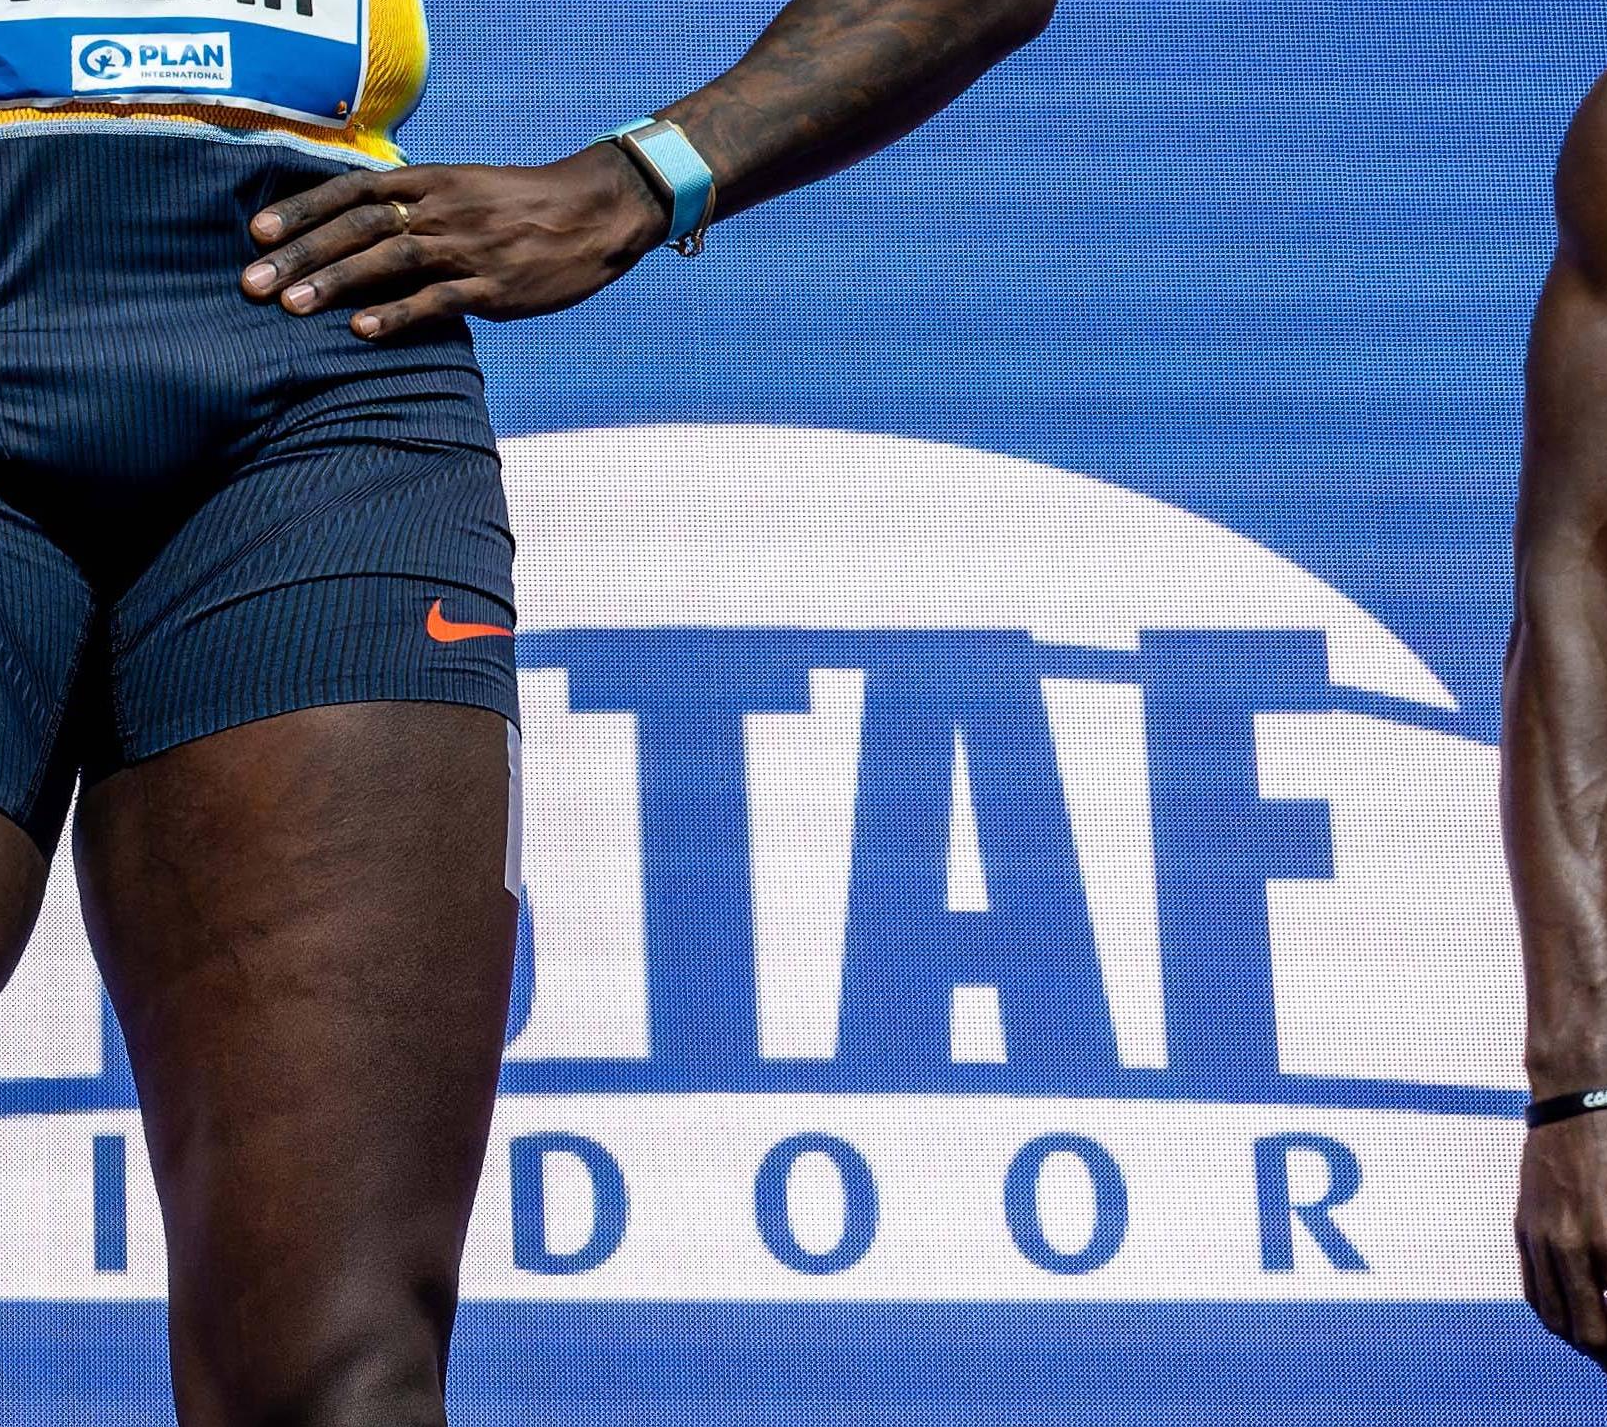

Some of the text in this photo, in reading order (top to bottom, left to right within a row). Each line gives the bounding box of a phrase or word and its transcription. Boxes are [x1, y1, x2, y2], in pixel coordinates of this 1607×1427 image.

[139, 44, 224, 68] PLAN
[140, 71, 225, 81] INTERNATIONAL
[92, 1130, 1370, 1276] IDOOR
